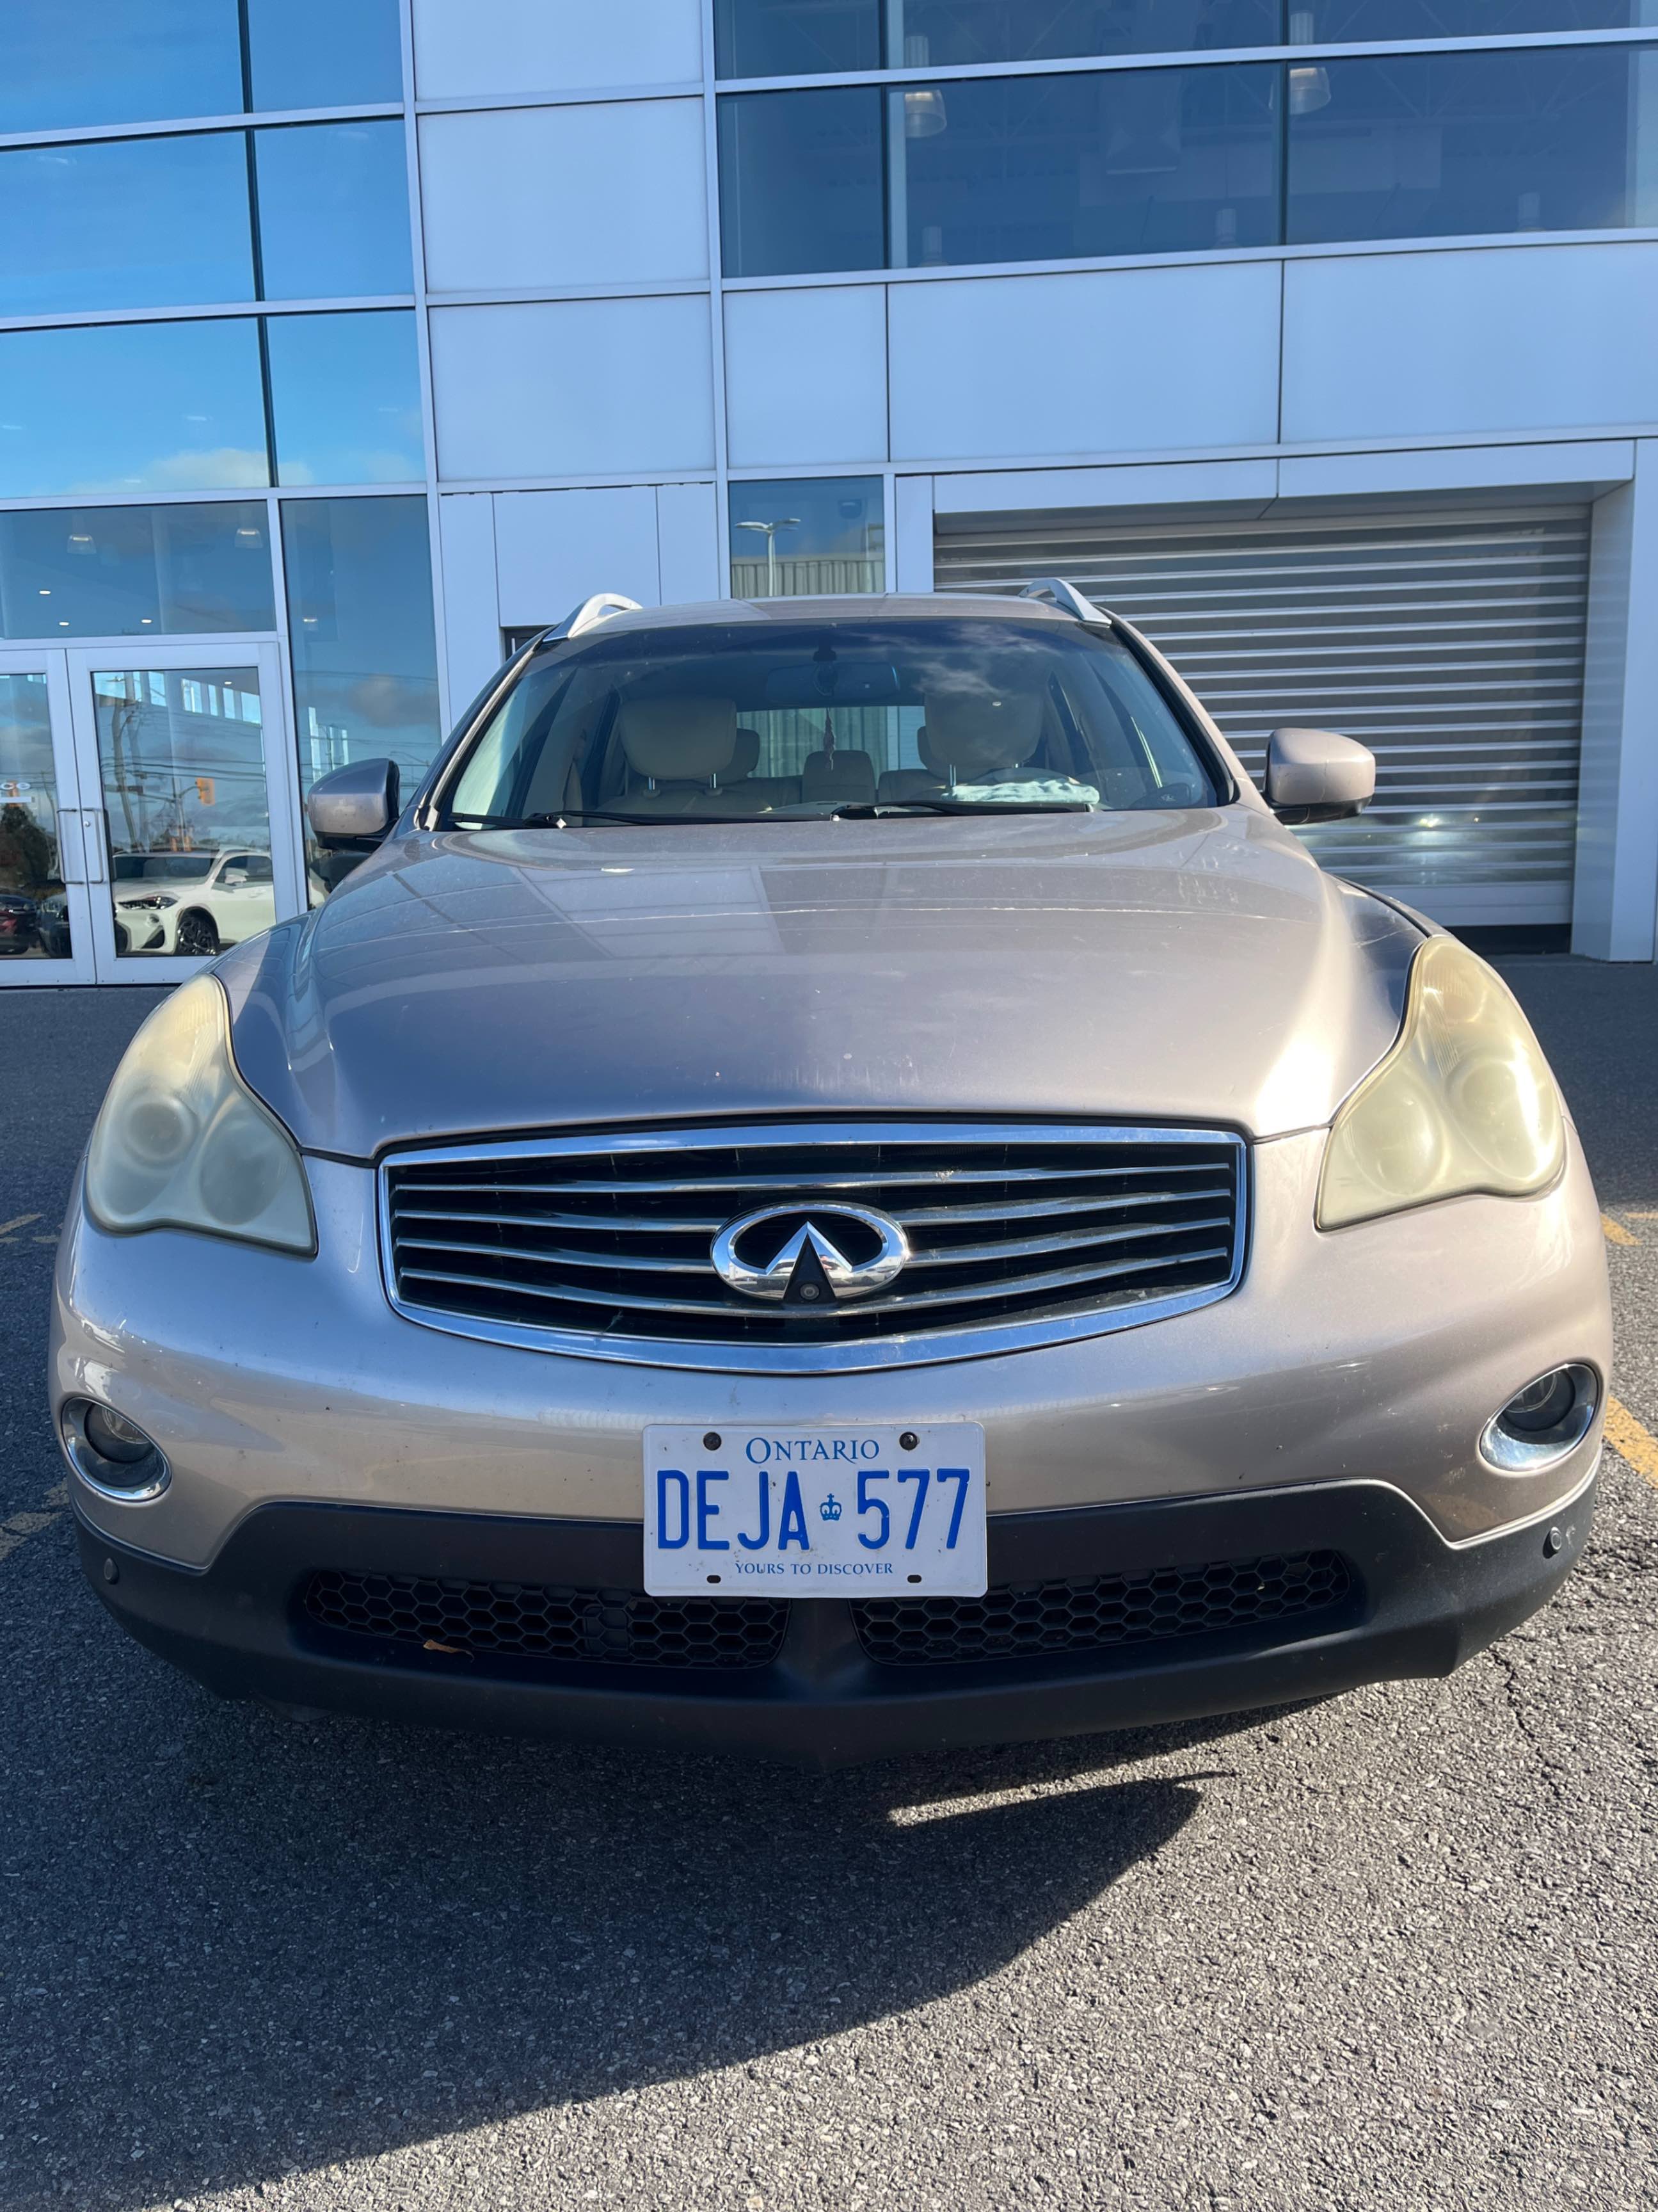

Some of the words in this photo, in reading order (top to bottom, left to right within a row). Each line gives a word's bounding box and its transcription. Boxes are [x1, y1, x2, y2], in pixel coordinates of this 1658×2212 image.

[657, 1469, 810, 1551] DEJA
[857, 1468, 971, 1550] 577
[735, 1563, 785, 1575] YOURS
[790, 1563, 811, 1575] TO
[817, 1563, 893, 1575] DISCOVER
